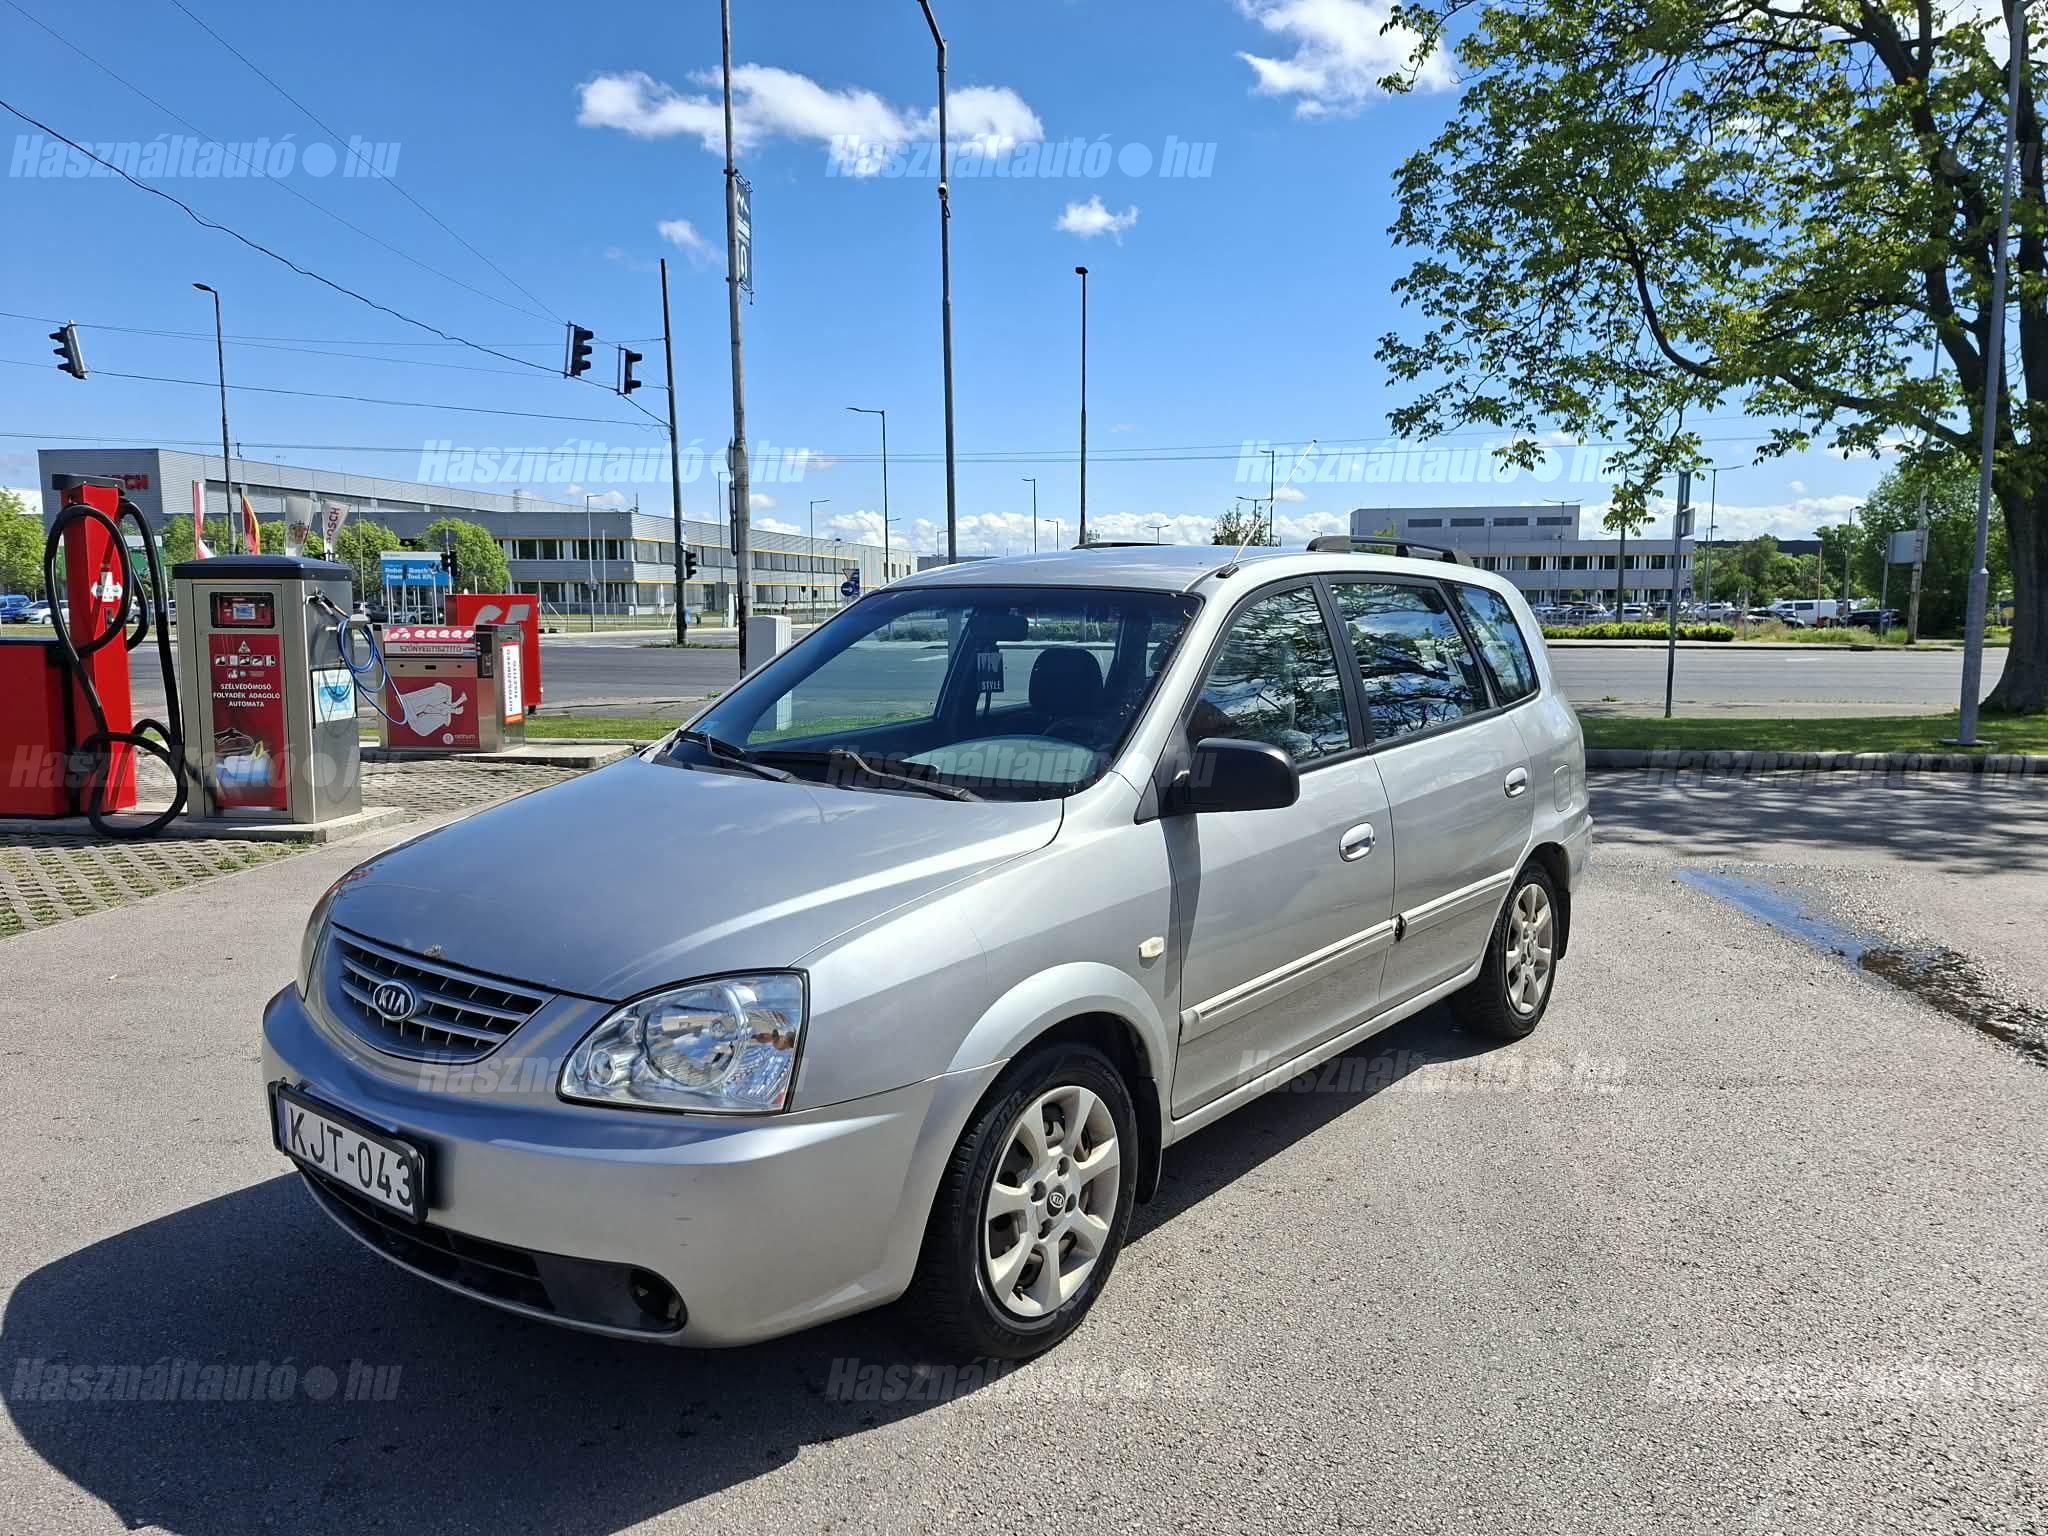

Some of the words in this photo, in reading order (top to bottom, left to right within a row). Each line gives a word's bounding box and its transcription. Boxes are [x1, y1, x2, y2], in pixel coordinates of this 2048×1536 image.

[213, 691, 246, 699] FOLYADÉK
[378, 988, 405, 1014] KIA
[289, 1107, 414, 1207] KJT-043
